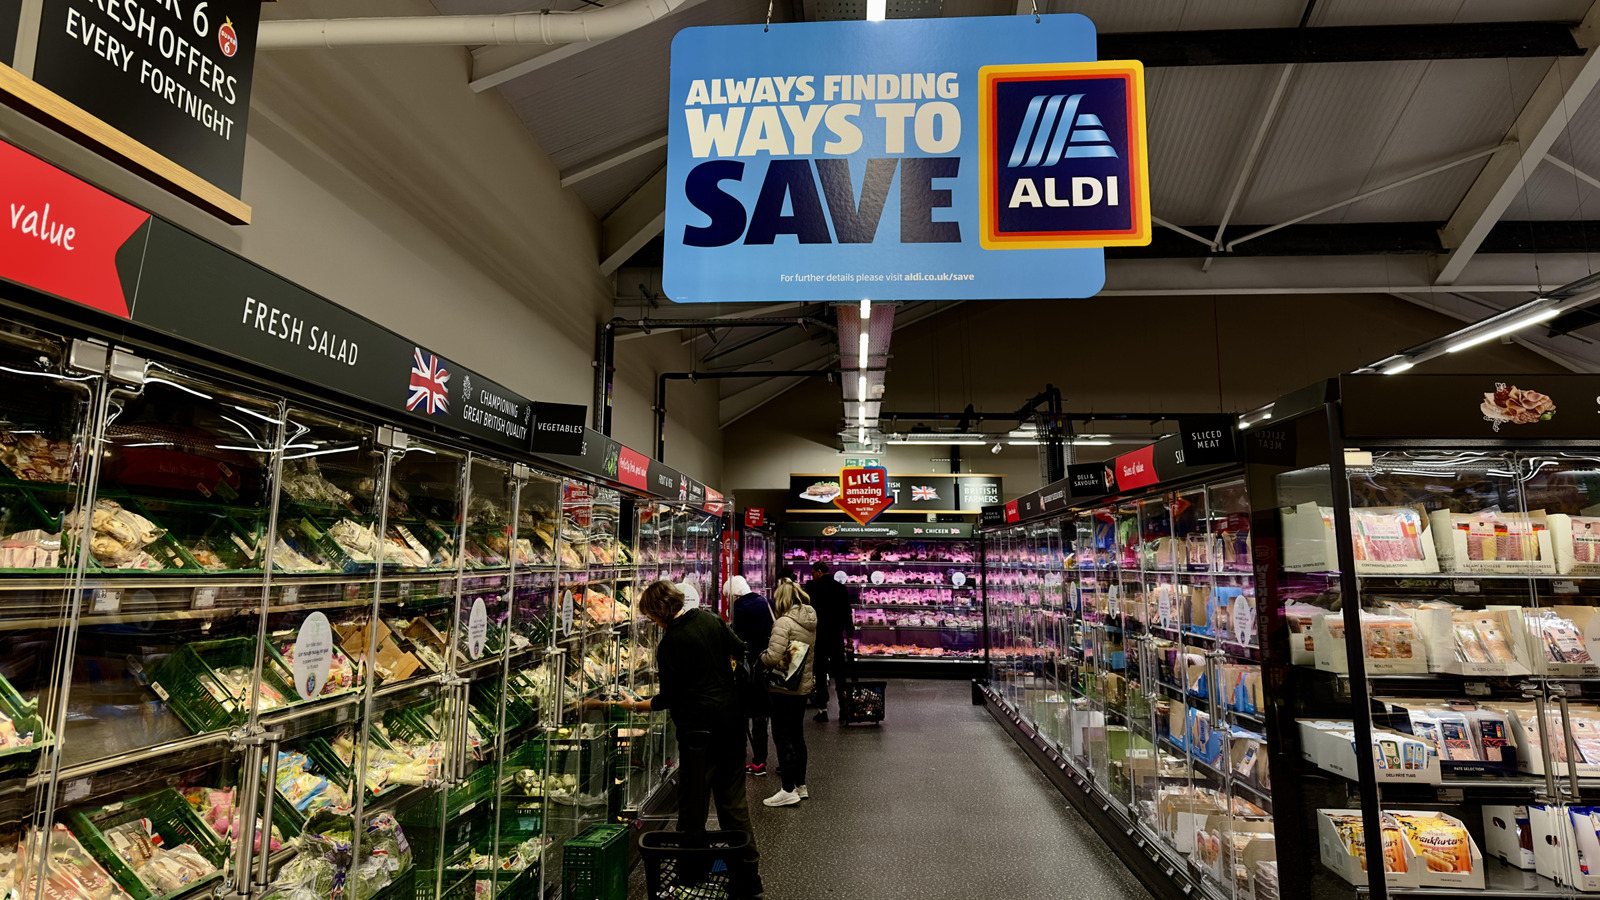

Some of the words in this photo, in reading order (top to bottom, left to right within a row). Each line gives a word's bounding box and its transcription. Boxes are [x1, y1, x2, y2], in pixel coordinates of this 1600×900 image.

[192, 1, 209, 37] 6
[220, 30, 237, 47] SUPER
[83, 0, 156, 46] ESH
[158, 25, 238, 105] OFFERS
[224, 41, 231, 54] 6
[65, 6, 134, 73] EVERY
[140, 58, 234, 140] FORTNIGHT
[685, 74, 815, 105] ALWAYS
[823, 72, 959, 101] FINDING
[684, 104, 863, 158] WAYS
[875, 101, 962, 154] TO
[1007, 175, 1119, 209] ALDI
[682, 157, 962, 248] SAVE
[10, 203, 76, 251] value
[780, 274, 794, 283] For
[795, 273, 825, 282] further
[826, 273, 855, 282] details
[855, 273, 884, 284] please
[885, 273, 903, 282] visit
[904, 272, 975, 282] aldi.co.uk/save
[242, 296, 305, 345] FRESH
[308, 325, 359, 366] SALAD
[480, 389, 519, 418] CHAMPIONING
[463, 404, 484, 424] GREAT
[483, 412, 506, 432] BRITISH
[505, 421, 528, 441] QUALITY
[537, 422, 583, 434] VEGETABLES
[1191, 430, 1222, 441] SLICED
[1197, 439, 1220, 449] MEAT
[848, 472, 880, 486] LIKE
[1073, 479, 1099, 487] SAVOURY
[846, 486, 882, 496] amazing
[964, 487, 998, 495] BRITISH
[847, 496, 882, 506] savings.
[964, 495, 999, 503] FARMERS
[1411, 832, 1464, 846] Frankfurters
